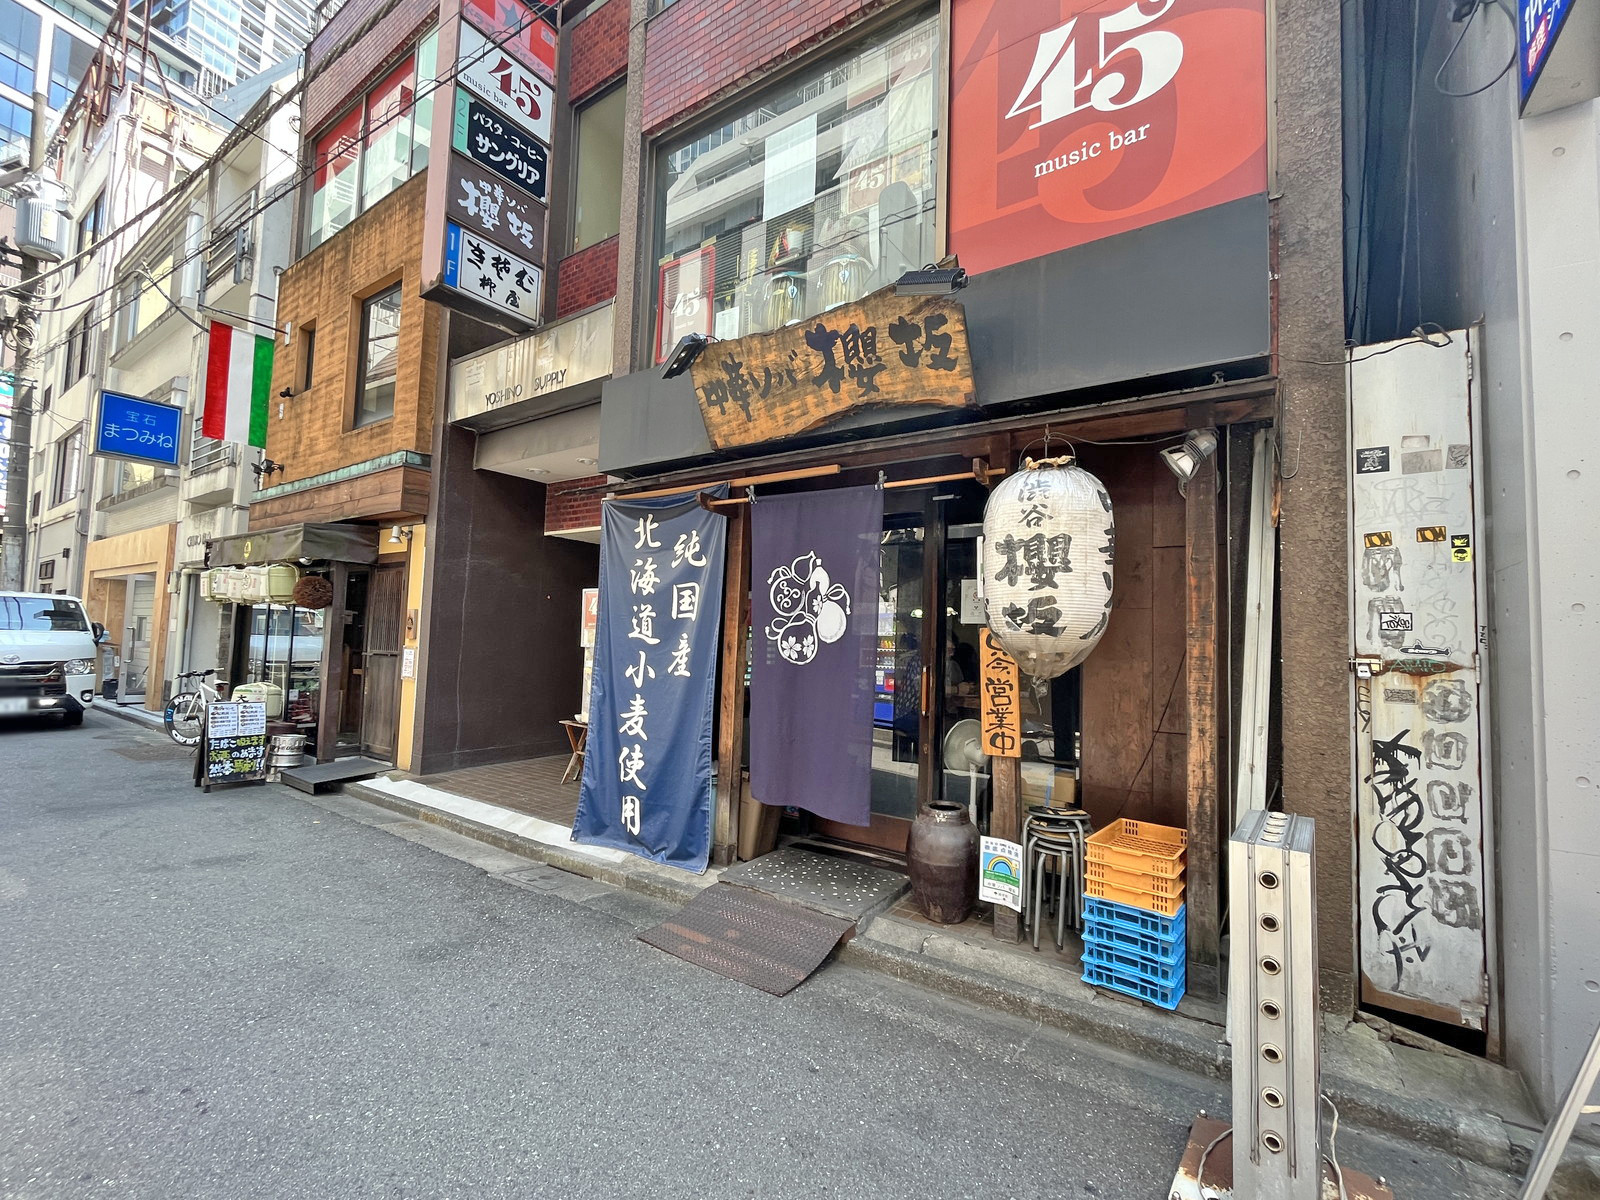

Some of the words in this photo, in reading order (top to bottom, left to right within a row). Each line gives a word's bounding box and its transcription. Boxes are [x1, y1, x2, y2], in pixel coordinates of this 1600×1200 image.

[1004, 0, 1184, 130] 45
[463, 72, 491, 97] music
[493, 87, 509, 109] bar
[488, 56, 541, 121] 45
[473, 111, 544, 161] パスタ・コーヒー
[476, 133, 540, 184] サングリア
[1034, 140, 1102, 178] music
[1108, 123, 1151, 151] bar
[479, 179, 529, 213] 中華ソバ
[855, 163, 885, 192] 45
[446, 232, 456, 275] 1F
[671, 287, 701, 318] 45
[484, 384, 523, 407] YOSHINO
[533, 369, 567, 391] SUPPLY
[701, 344, 799, 422] 中華ソバ
[104, 422, 174, 449] まつみね
[126, 411, 157, 427] 宝石
[667, 529, 707, 678] 純国産
[618, 513, 662, 836] 北海道小麦使用
